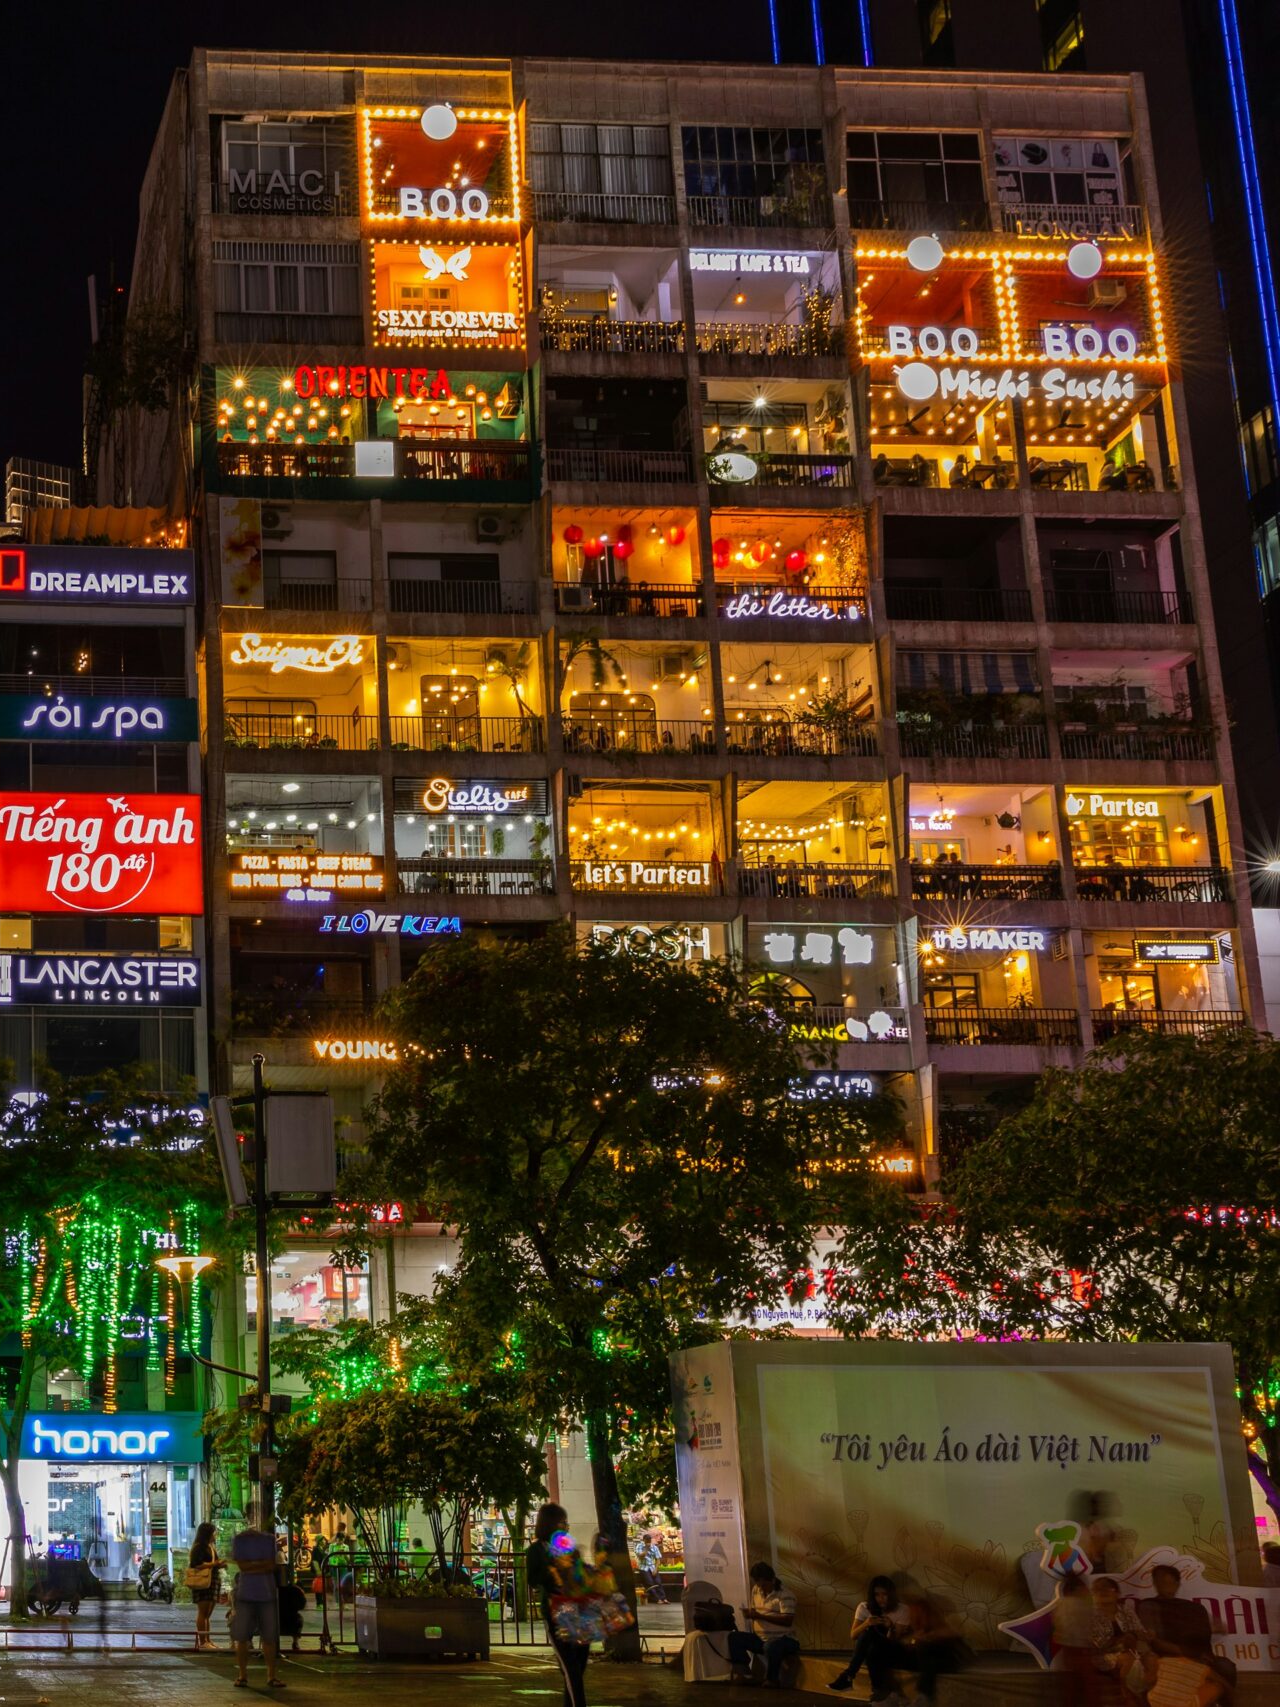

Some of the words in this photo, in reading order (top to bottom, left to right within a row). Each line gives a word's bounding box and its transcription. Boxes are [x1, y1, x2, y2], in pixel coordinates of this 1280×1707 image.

[229, 168, 340, 197] MACI
[237, 196, 334, 212] COSMETICS
[400, 187, 489, 219] BOO
[784, 255, 810, 273] TEA
[378, 309, 427, 328] SEXY
[430, 310, 519, 330] FOREVER
[889, 325, 978, 357] BOO
[1044, 328, 1136, 360] BOO
[294, 364, 453, 399] ORIENTEA
[940, 367, 1029, 401] Michi
[1040, 367, 1134, 401] Sushi
[30, 572, 187, 595] DREAMPLEX
[726, 593, 765, 618] the
[91, 706, 163, 737] spa
[1089, 794, 1160, 817] Partea
[46, 853, 121, 892] 180
[241, 856, 270, 869] PIZZA
[277, 857, 308, 870] PASTA
[584, 861, 625, 884] let's
[630, 862, 710, 885] Partea!
[319, 915, 336, 932] I
[336, 909, 402, 934] LOVE
[400, 915, 462, 936] KEM
[592, 924, 711, 961] DOSH
[933, 930, 968, 950] the
[968, 930, 1045, 951] MAKER
[20, 959, 197, 987] LANCASTER
[55, 990, 160, 1001] LINCOLN
[34, 1419, 170, 1455] honor
[877, 1436, 927, 1470] yêu
[933, 1427, 969, 1463] Áo
[975, 1432, 1021, 1463] dài
[1028, 1434, 1081, 1470] Việt
[150, 1481, 168, 1493] 44
